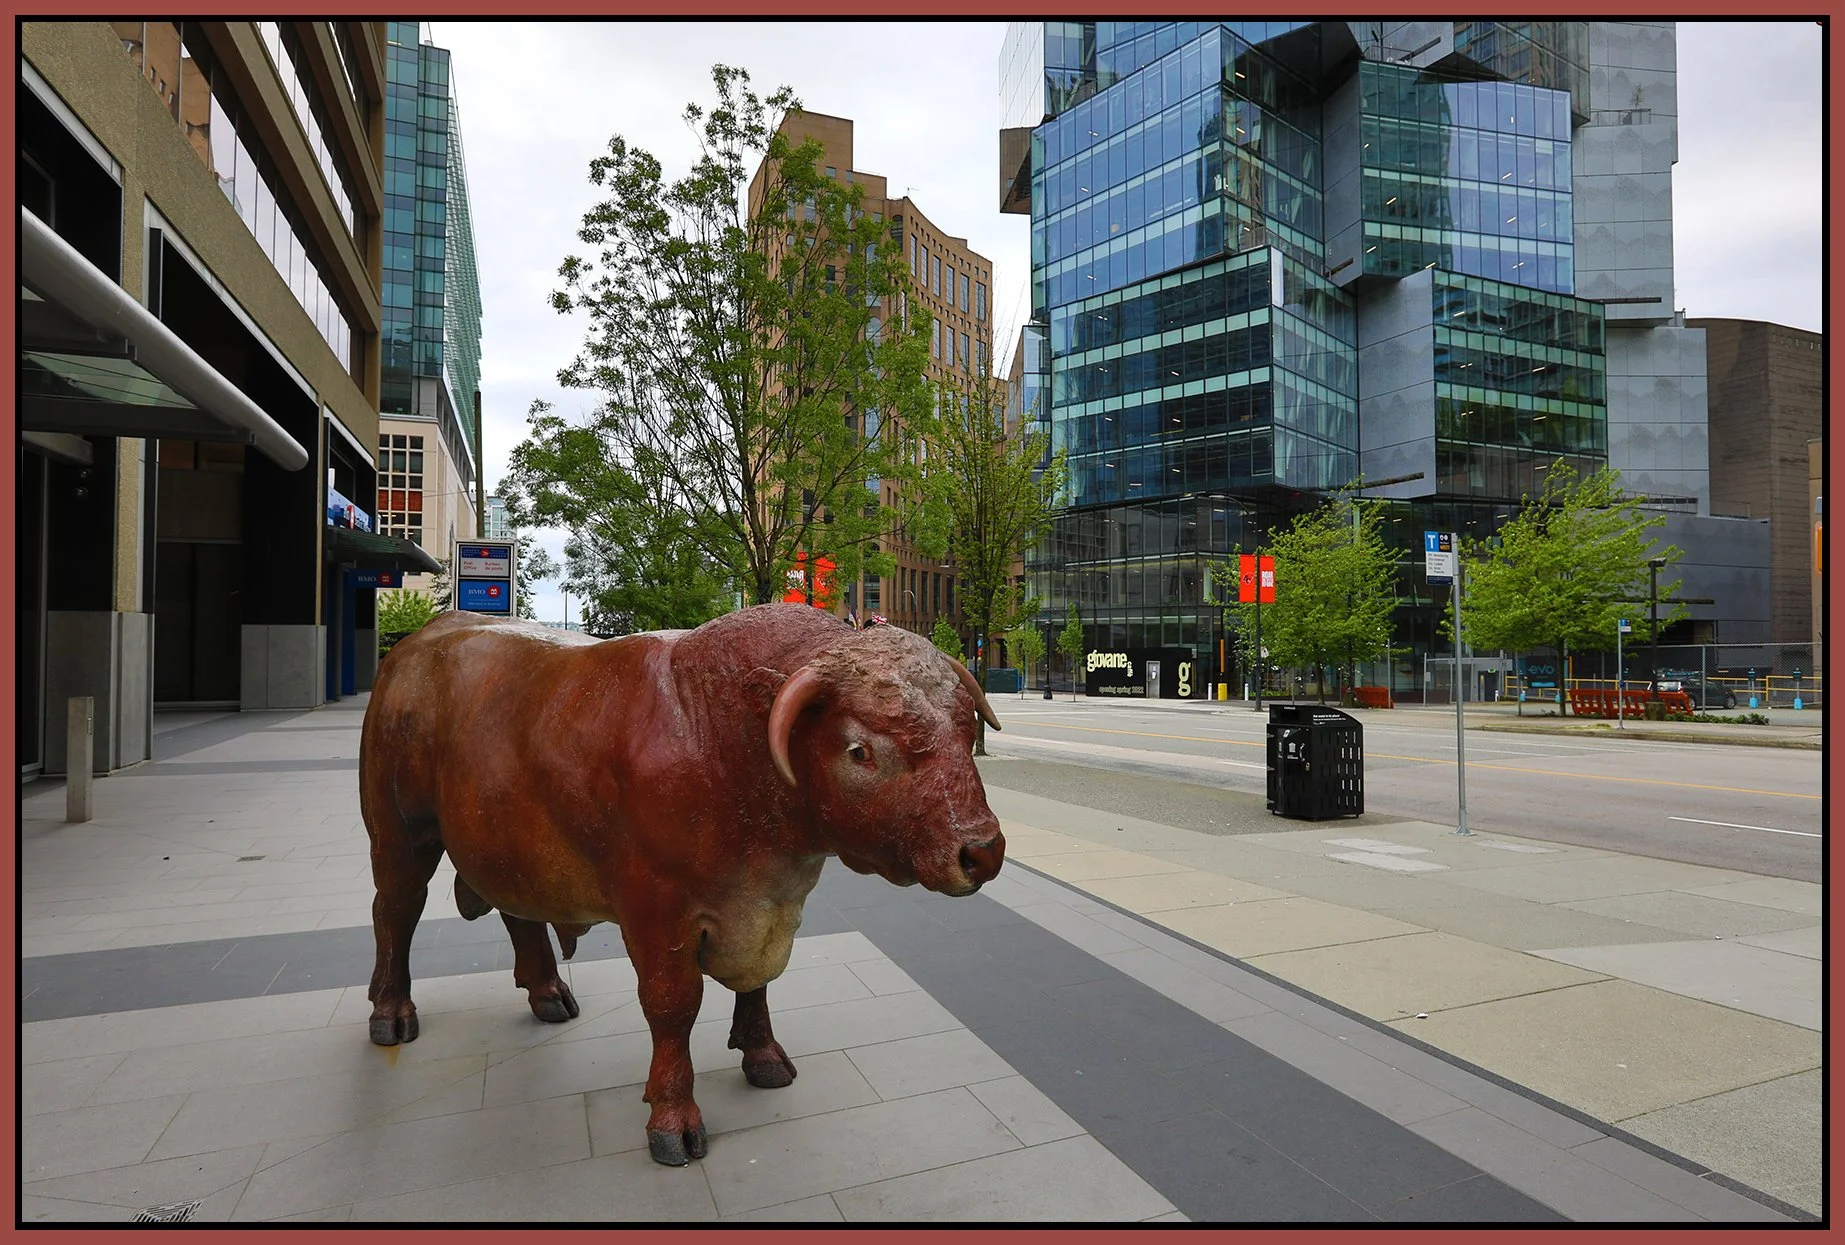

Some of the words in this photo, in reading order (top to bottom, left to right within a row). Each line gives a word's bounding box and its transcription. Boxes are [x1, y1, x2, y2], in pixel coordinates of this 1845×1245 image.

[1427, 534, 1436, 549] T
[1087, 649, 1128, 672] giovane
[1529, 664, 1555, 675] evo
[1177, 661, 1191, 697] g
